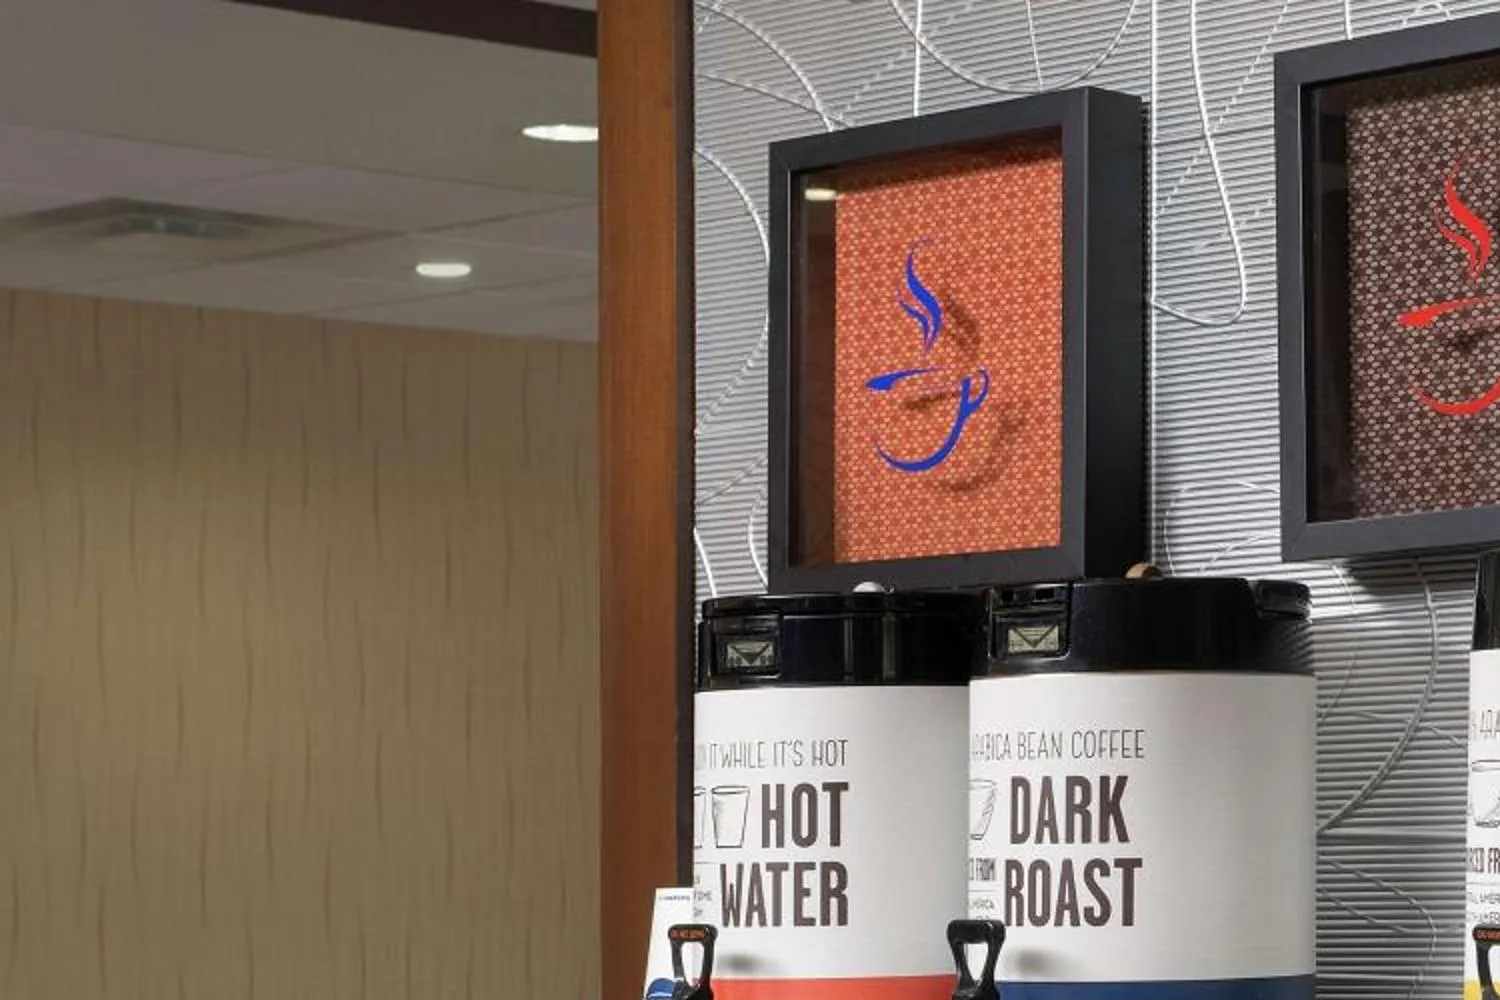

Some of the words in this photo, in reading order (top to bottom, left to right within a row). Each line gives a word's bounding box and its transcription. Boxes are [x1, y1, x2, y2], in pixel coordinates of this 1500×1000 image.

[721, 741, 765, 769] WHILE
[774, 739, 804, 768] IT'S
[811, 739, 848, 768] HOT
[1017, 731, 1063, 760] BEAN
[1071, 729, 1145, 759] COFFEE
[761, 781, 849, 849] HOT
[1010, 775, 1130, 845] DARK
[720, 861, 849, 928] WATER
[1004, 857, 1143, 927] ROAST
